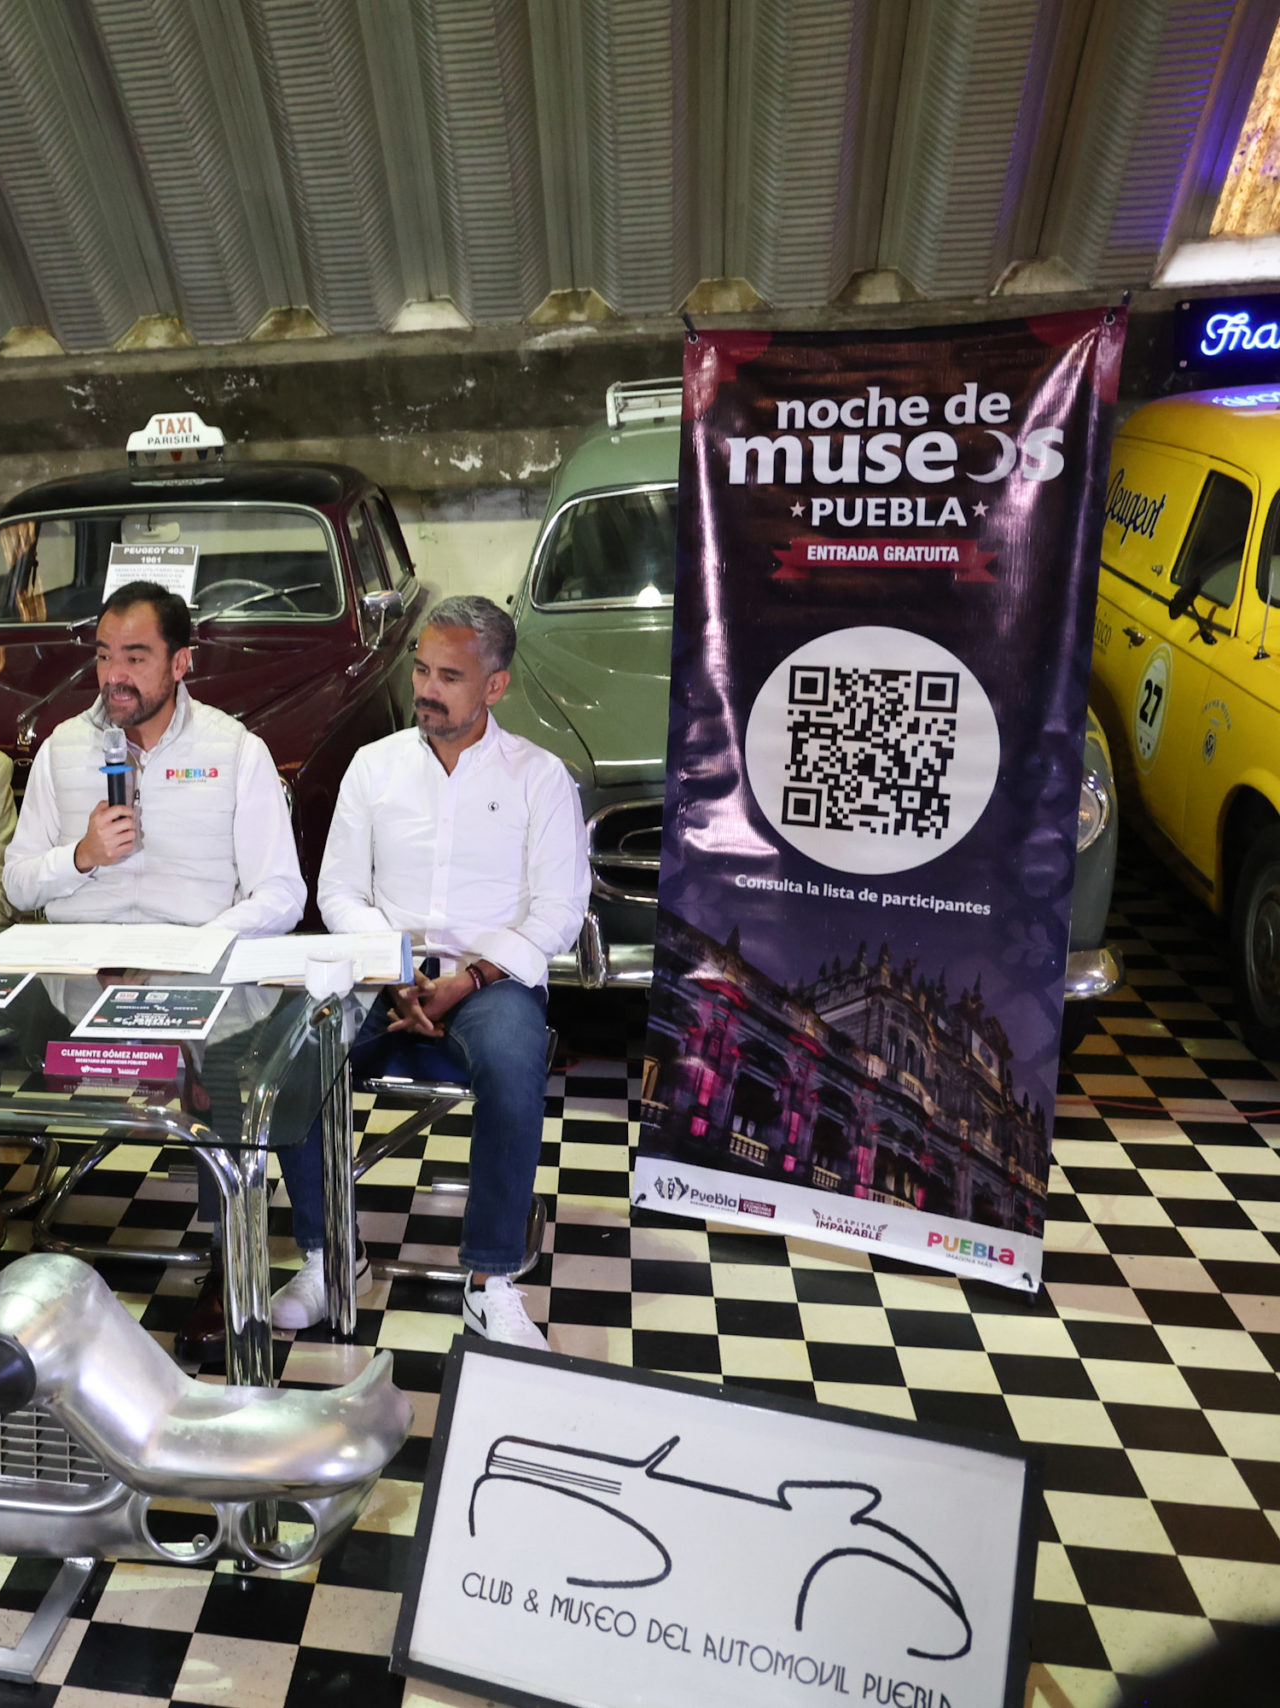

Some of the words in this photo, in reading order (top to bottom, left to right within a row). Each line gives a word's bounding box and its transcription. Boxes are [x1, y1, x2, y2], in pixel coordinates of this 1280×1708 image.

[776, 386, 930, 430] noche
[944, 382, 1011, 425] de
[156, 416, 193, 435] TAXI
[148, 435, 200, 445] PARISIEN
[726, 428, 1065, 485] museos
[811, 497, 967, 527] PUEBLA
[124, 547, 166, 555] PEUGEOT
[807, 546, 879, 561] ENTRADA
[884, 546, 960, 563] GRATUITA
[1140, 678, 1163, 728] 27
[735, 874, 803, 894] Consulta
[807, 881, 820, 896] la
[823, 884, 855, 900] lista
[858, 888, 878, 903] de
[882, 892, 991, 916] participantes
[61, 1049, 101, 1058] CLEMENTE
[102, 1049, 131, 1059] GÓMEZ
[132, 1052, 164, 1060] MEDINA
[691, 1189, 737, 1208] Puebla
[816, 1220, 883, 1242] IMPARABLE
[837, 1218, 876, 1233] CAPITAL
[462, 1572, 514, 1606] CLUB
[523, 1589, 539, 1613] &
[550, 1594, 637, 1638] MUSEO
[647, 1619, 691, 1654] DEL
[702, 1633, 850, 1695] AUTOMOVIL
